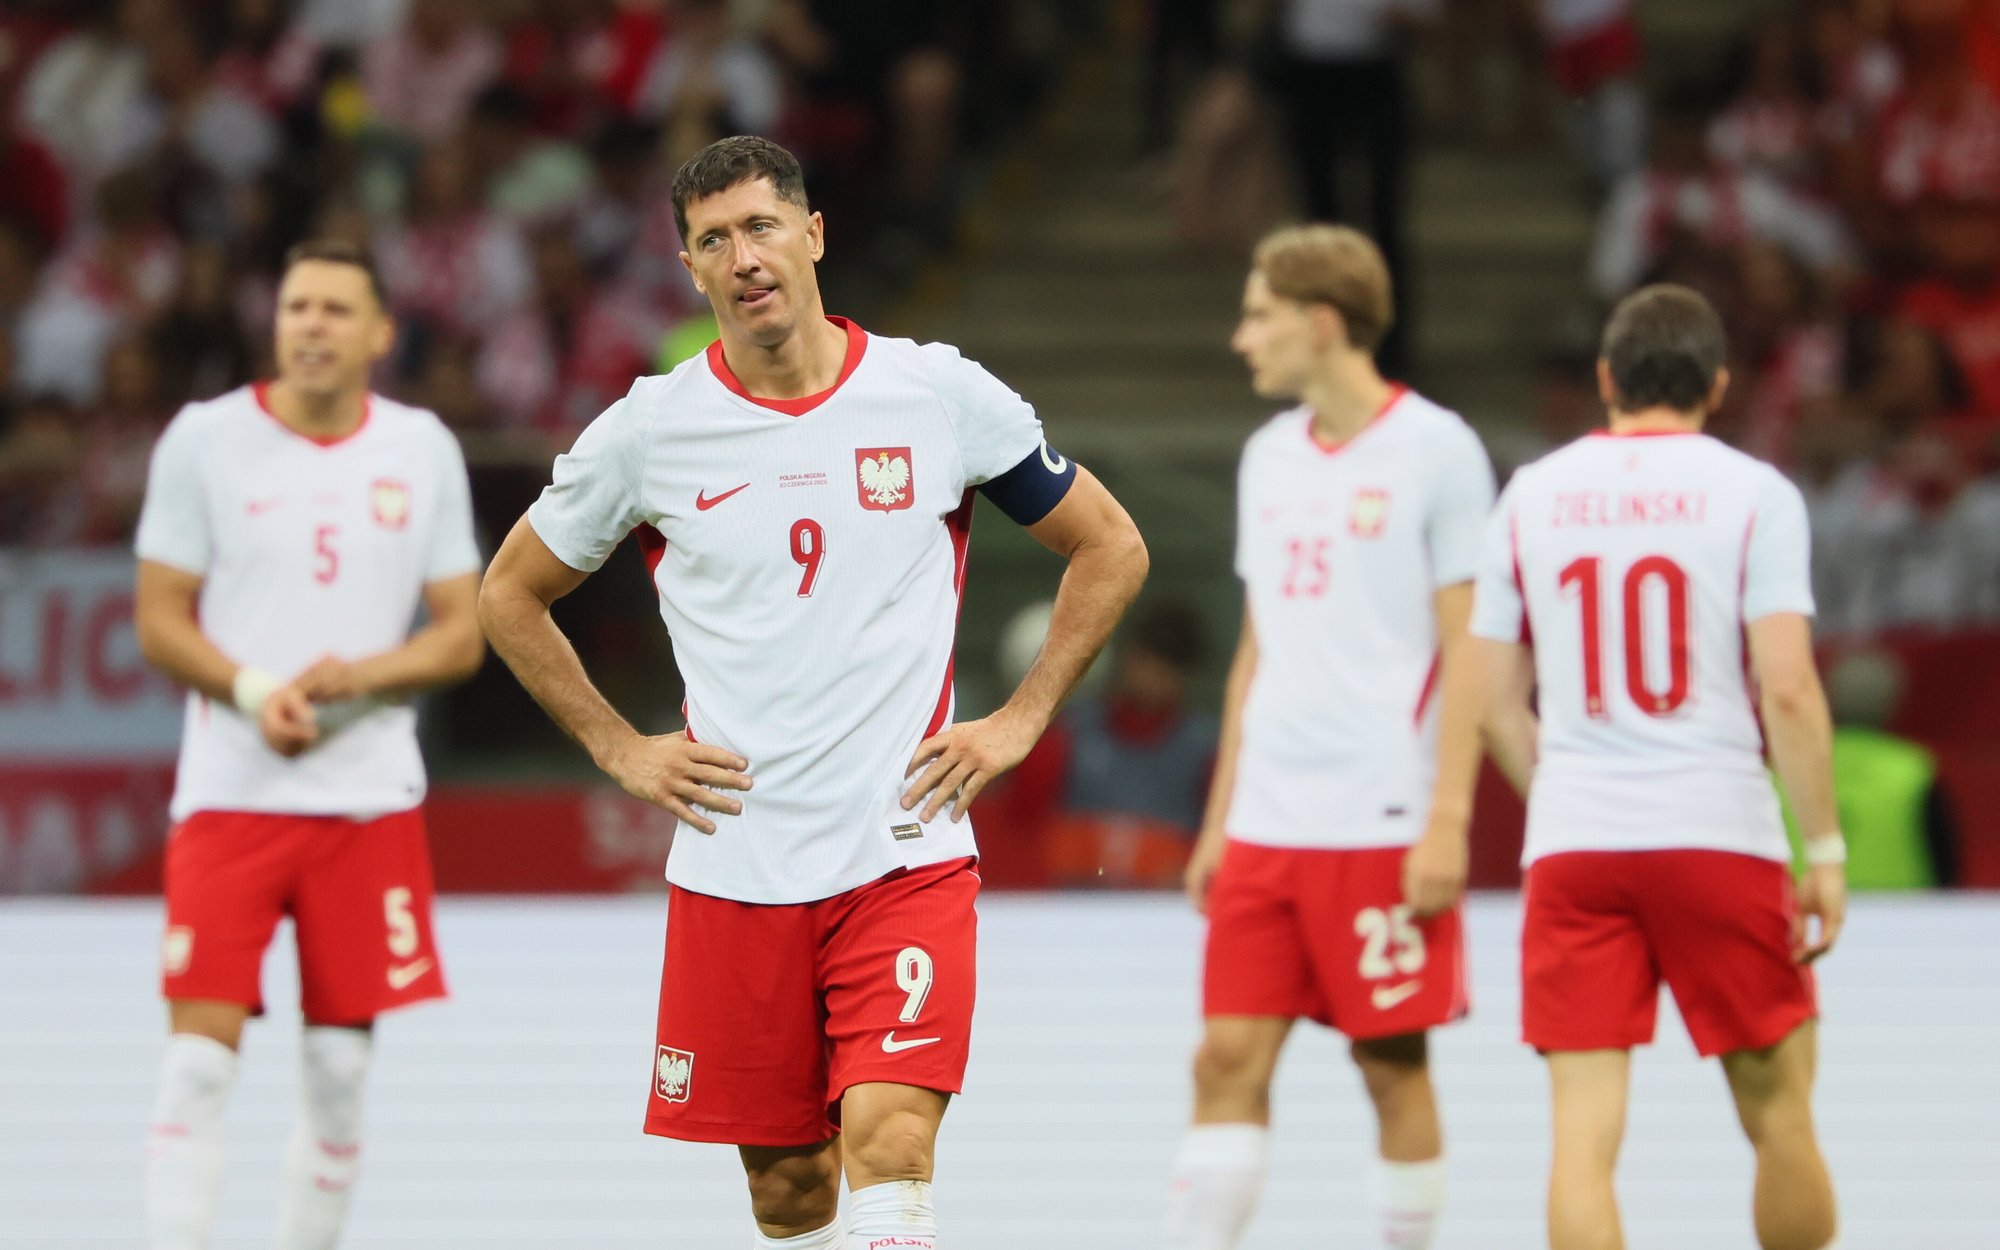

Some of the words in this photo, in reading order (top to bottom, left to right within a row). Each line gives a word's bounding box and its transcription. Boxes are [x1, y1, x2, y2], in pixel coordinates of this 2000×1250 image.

[779, 472, 827, 481] POLSKA-NIGERIA
[313, 524, 341, 587] 5
[790, 518, 826, 598] 9
[1281, 538, 1330, 599] 25
[1557, 554, 1690, 721] 10
[383, 886, 418, 956] 5
[1353, 903, 1427, 980] 25
[895, 946, 933, 1023] 9
